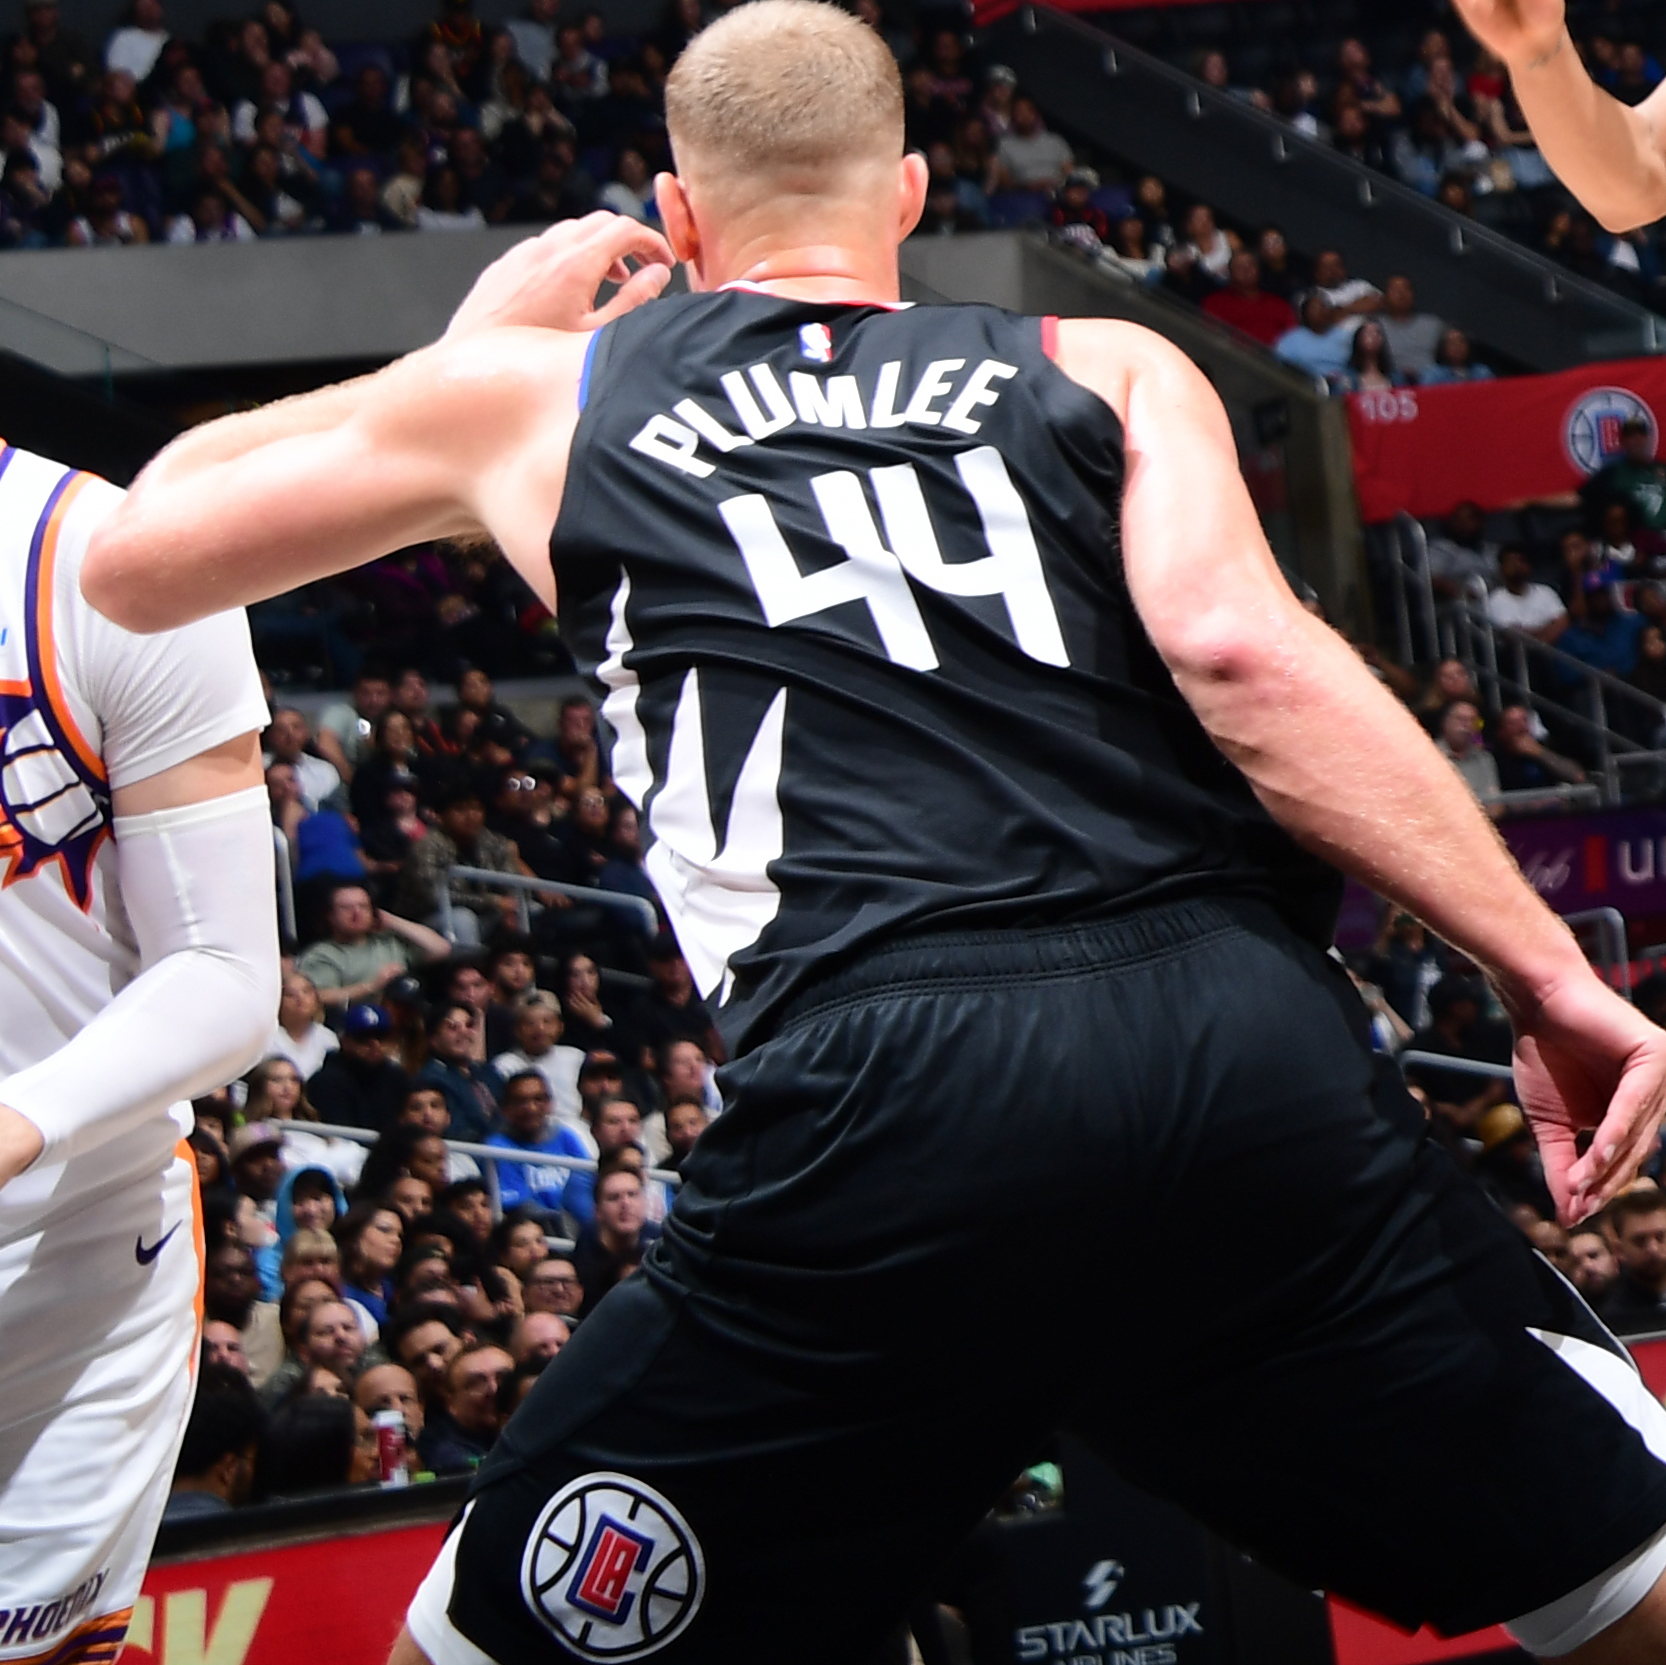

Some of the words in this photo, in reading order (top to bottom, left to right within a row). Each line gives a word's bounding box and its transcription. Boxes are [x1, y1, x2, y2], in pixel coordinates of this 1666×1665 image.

[629, 357, 1019, 480] PLUMLEE
[1358, 390, 1419, 426] 105
[718, 444, 1072, 672] 44
[1012, 1600, 1205, 1662] STARLUX
